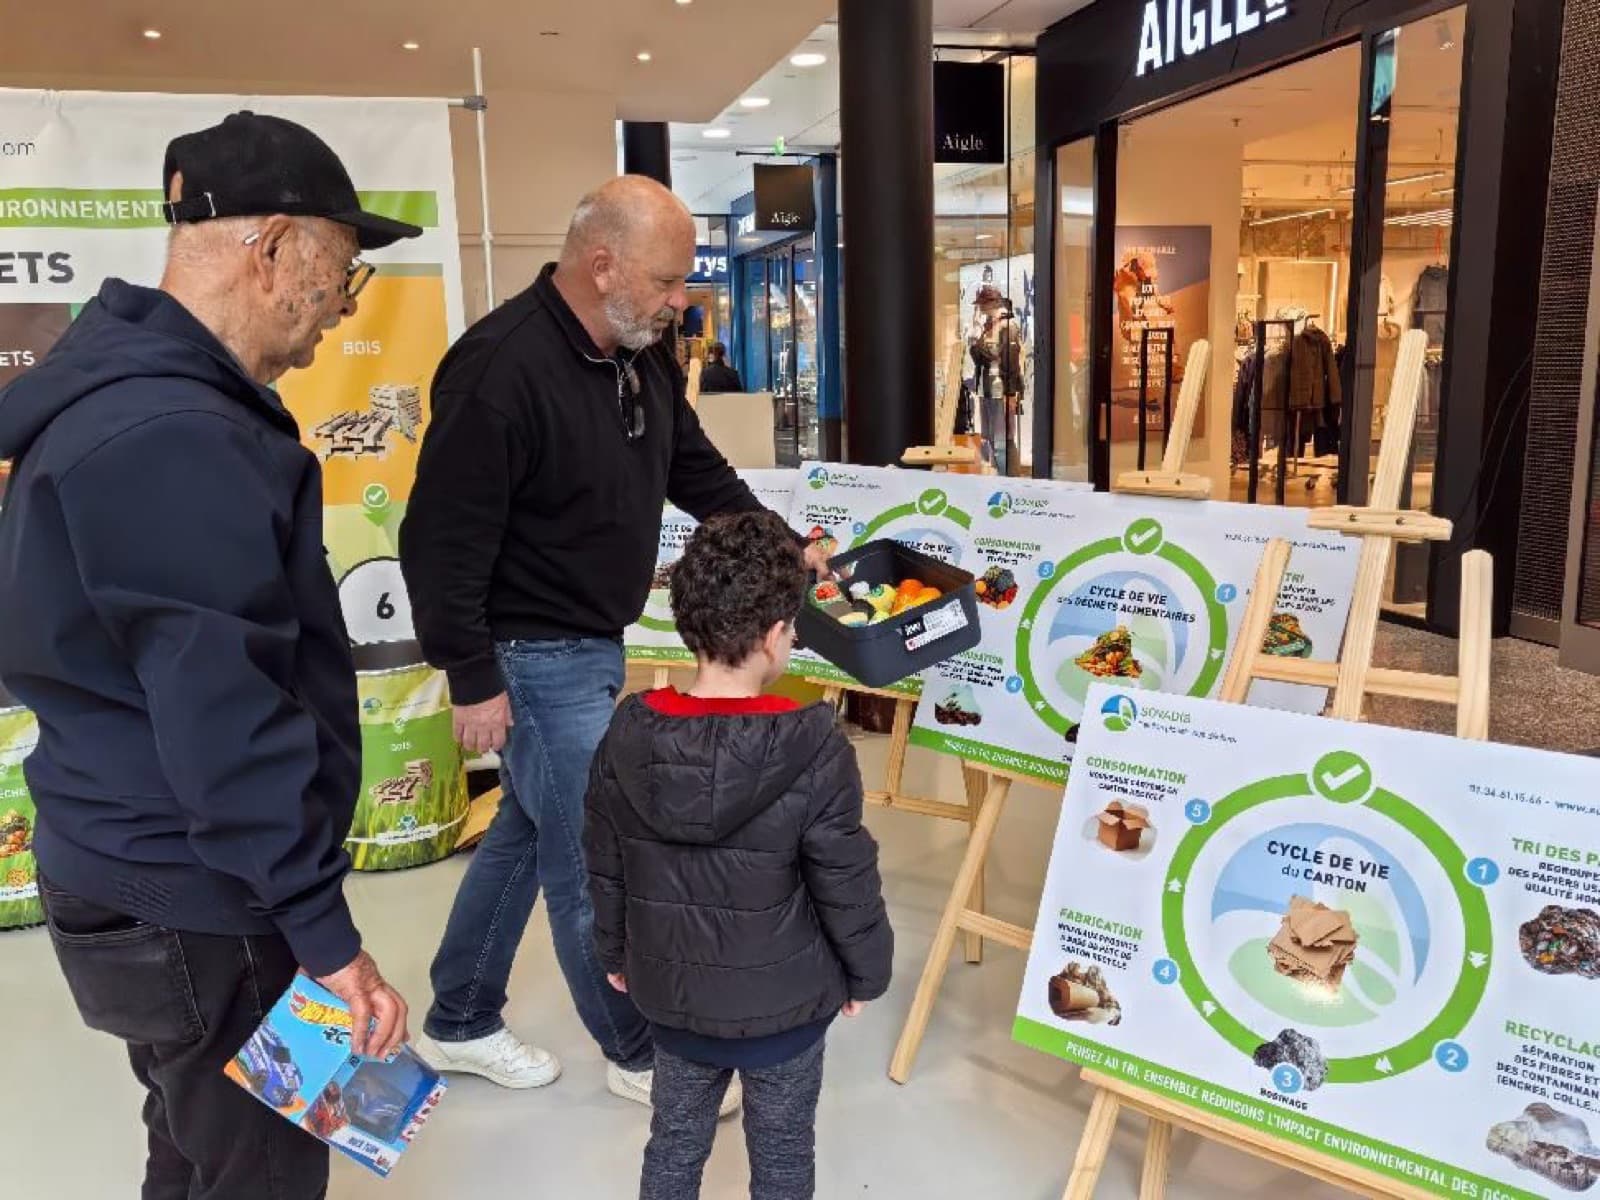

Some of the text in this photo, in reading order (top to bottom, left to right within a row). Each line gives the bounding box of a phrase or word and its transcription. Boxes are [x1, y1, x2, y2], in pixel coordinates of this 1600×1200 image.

[0, 142, 35, 156] om
[942, 133, 984, 154] Aigle
[0, 198, 163, 219] IRONNEMENT
[0, 251, 75, 284] ETS
[694, 256, 728, 277] rys
[0, 350, 36, 367] ETS
[343, 339, 382, 355] BOIS
[376, 591, 396, 620] 6
[1089, 585, 1168, 605] CYCLE DE VIE
[1120, 603, 1196, 623] ALIMENTAIRES
[1086, 755, 1187, 785] CONSOMMATION
[1267, 840, 1391, 880] CYCLE DE VIE
[1512, 837, 1541, 855] TRI
[1545, 844, 1581, 862] DES
[1282, 864, 1368, 893] du CARTON
[1508, 866, 1600, 893] DES PAPIERS US
[1539, 861, 1600, 882] REGROUPE
[1060, 907, 1144, 940] FABRICATION
[1505, 1019, 1600, 1059] RECYCLAG
[1496, 1061, 1600, 1100] DES CONTAMINAN
[1514, 1054, 1600, 1086] DES FIBRES ET
[1066, 1041, 1101, 1065] PENSEZ
[1104, 1055, 1119, 1070] AU
[1143, 1069, 1201, 1099] ENSEMBLE
[1201, 1088, 1265, 1122] RÉDUISONS
[1268, 1112, 1321, 1142] L'IMPACT
[1323, 1132, 1448, 1188] ENVIRONNEMENTAL
[1452, 1177, 1478, 1198] DES
